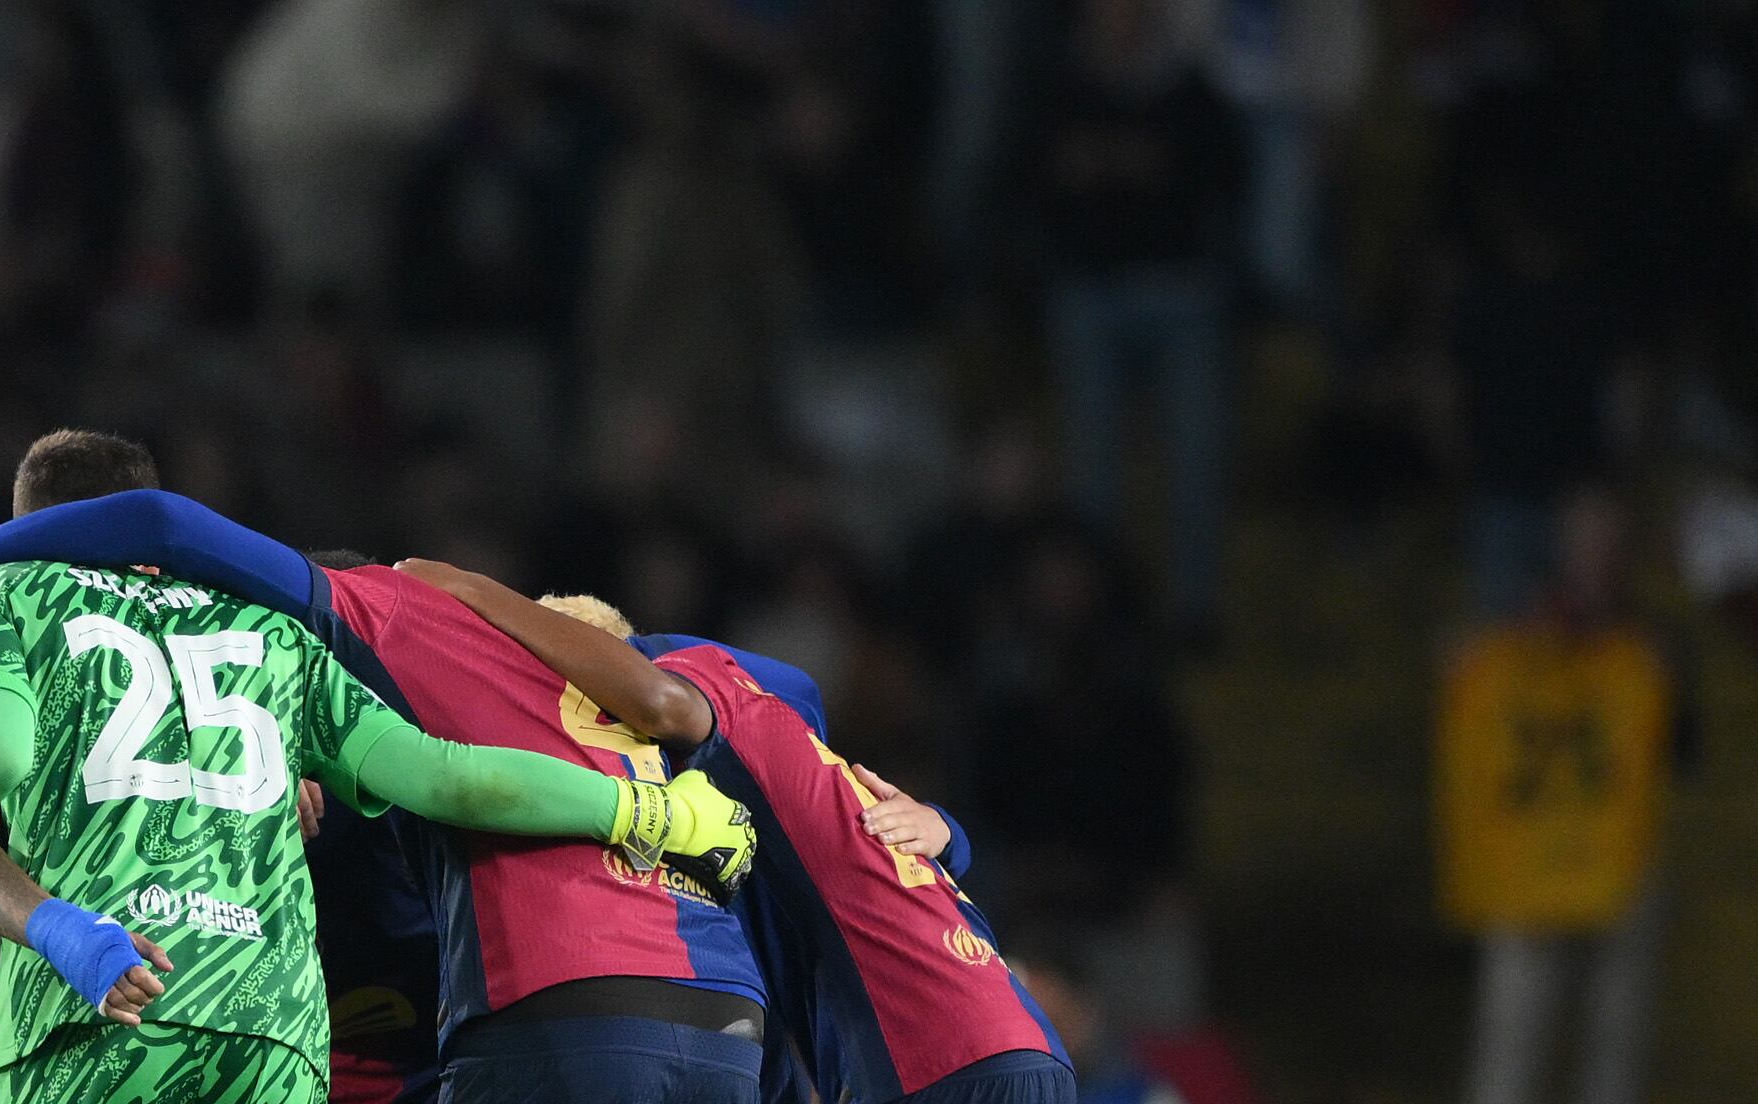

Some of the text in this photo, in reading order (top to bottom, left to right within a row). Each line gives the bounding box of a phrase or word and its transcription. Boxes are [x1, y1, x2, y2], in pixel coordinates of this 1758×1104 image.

[63, 614, 288, 815] 25
[185, 907, 264, 937] ACNUR
[186, 890, 260, 923] UNHCR
